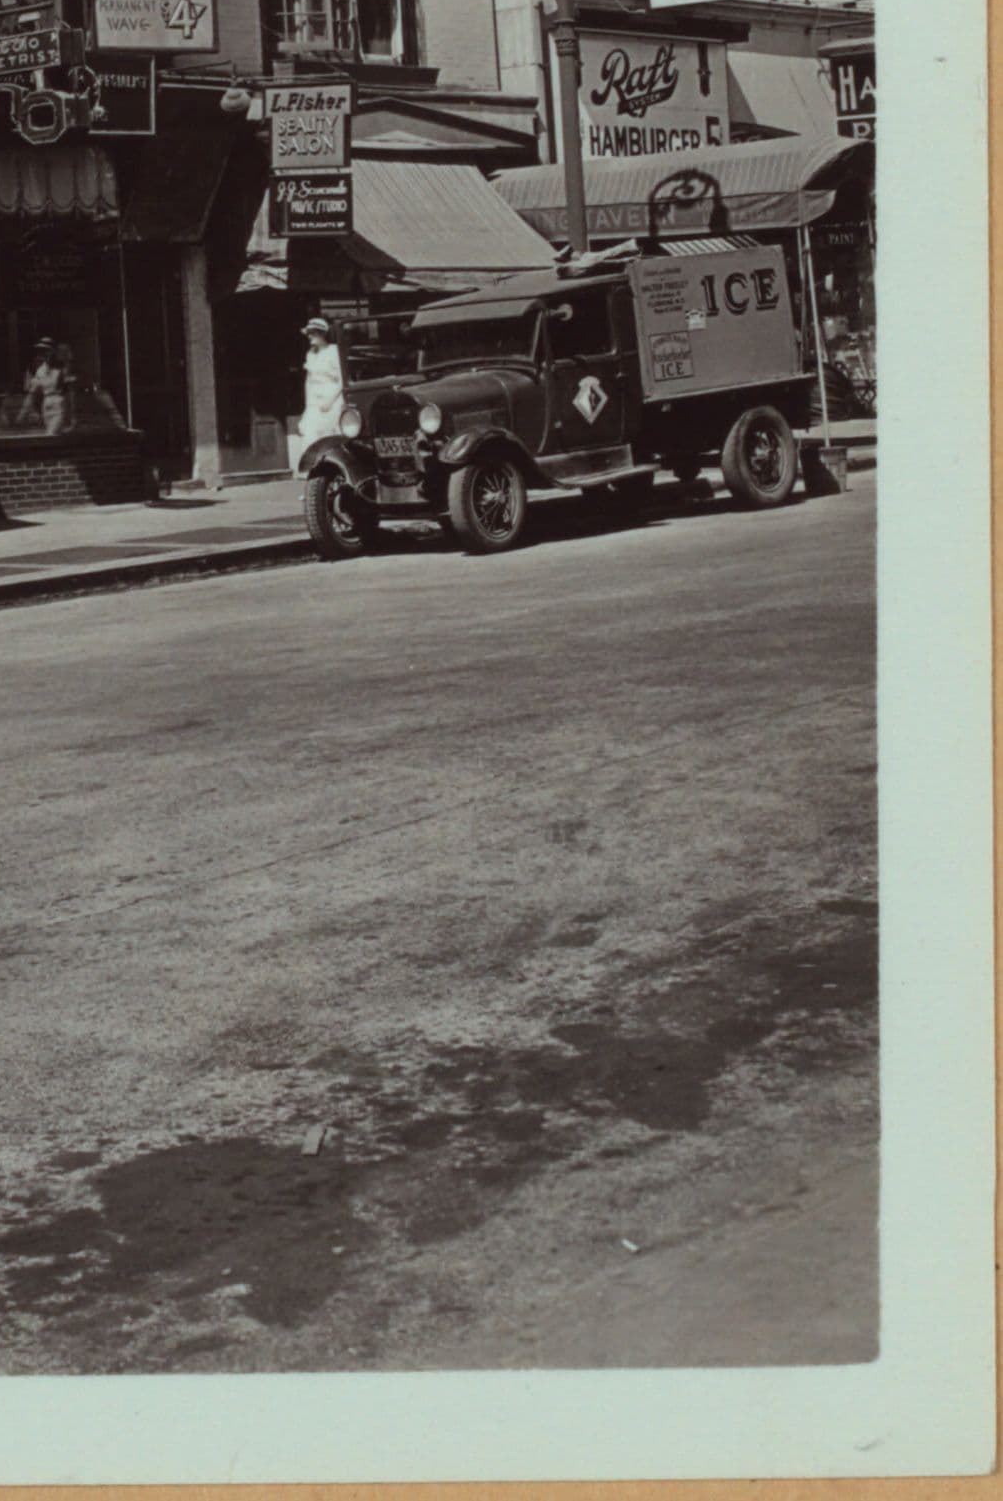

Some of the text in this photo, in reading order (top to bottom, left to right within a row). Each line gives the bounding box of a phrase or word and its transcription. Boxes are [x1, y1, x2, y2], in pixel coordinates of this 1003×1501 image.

[108, 16, 150, 32] WAVE
[278, 115, 339, 136] BEAUTY
[278, 136, 336, 156] SALON
[700, 268, 780, 317] ICE
[661, 361, 685, 378] ICE
